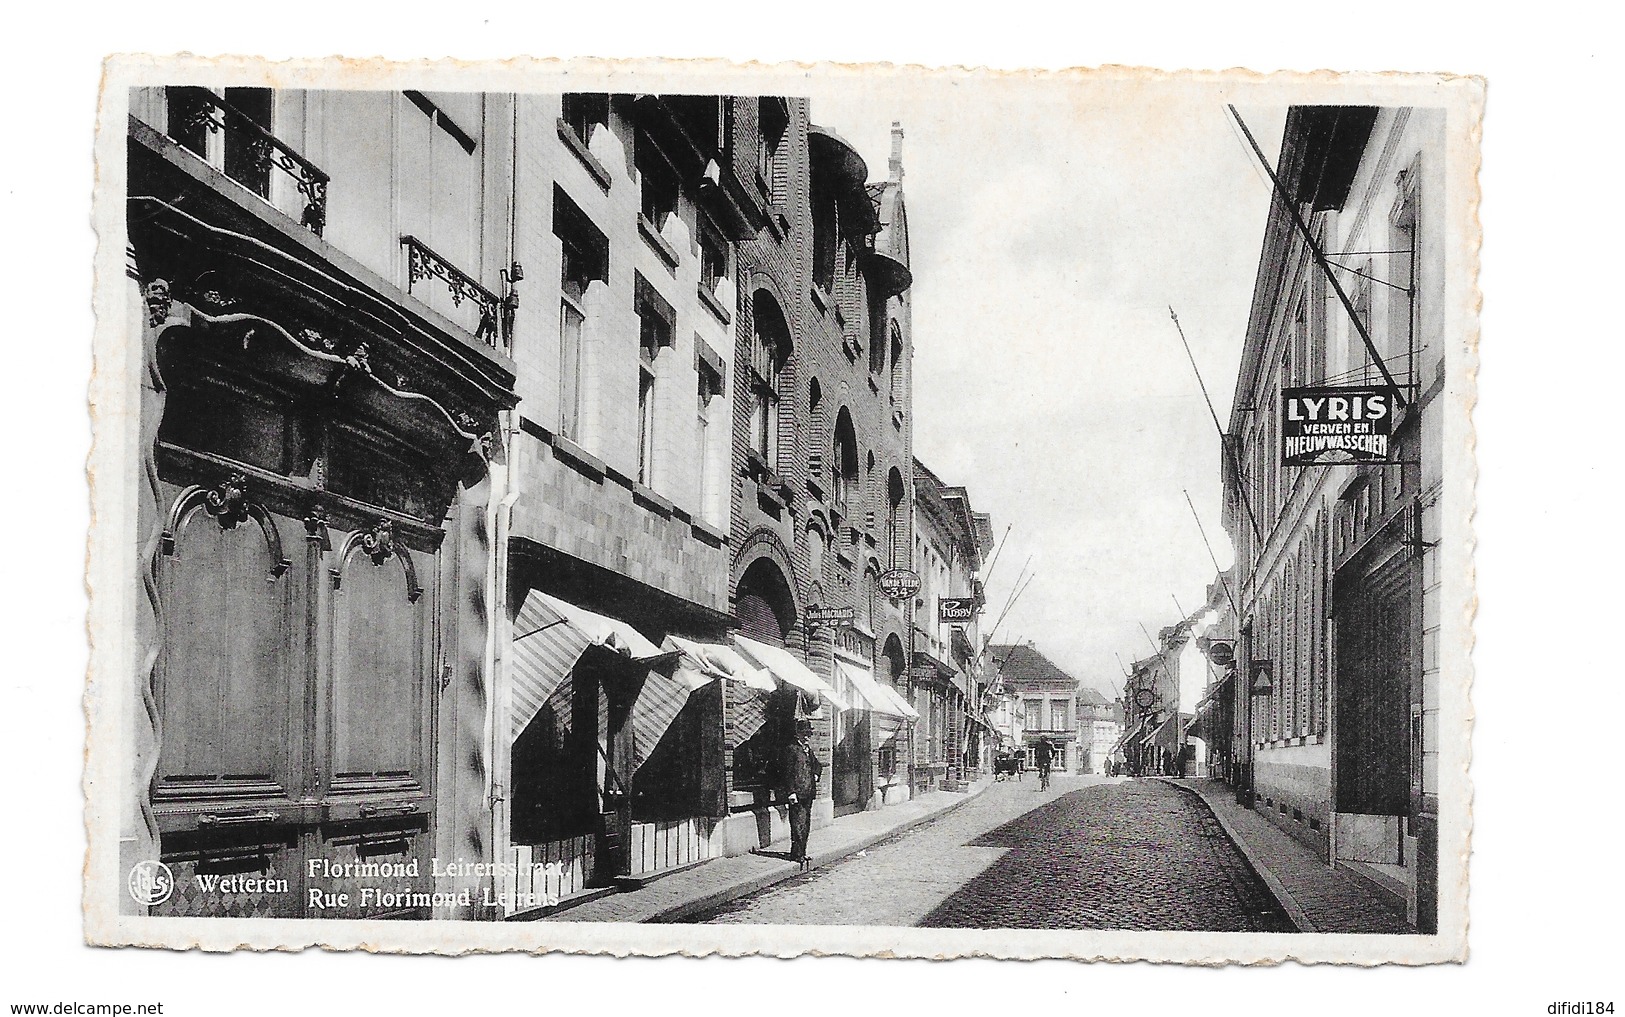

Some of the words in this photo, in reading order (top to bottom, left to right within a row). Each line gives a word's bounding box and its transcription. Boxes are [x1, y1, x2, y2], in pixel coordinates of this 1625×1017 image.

[1287, 395, 1387, 421] LYRIS
[1302, 423, 1352, 434] VERVEN
[1353, 422, 1370, 434] EN
[1285, 434, 1388, 459] NIEUWWASSCHEN
